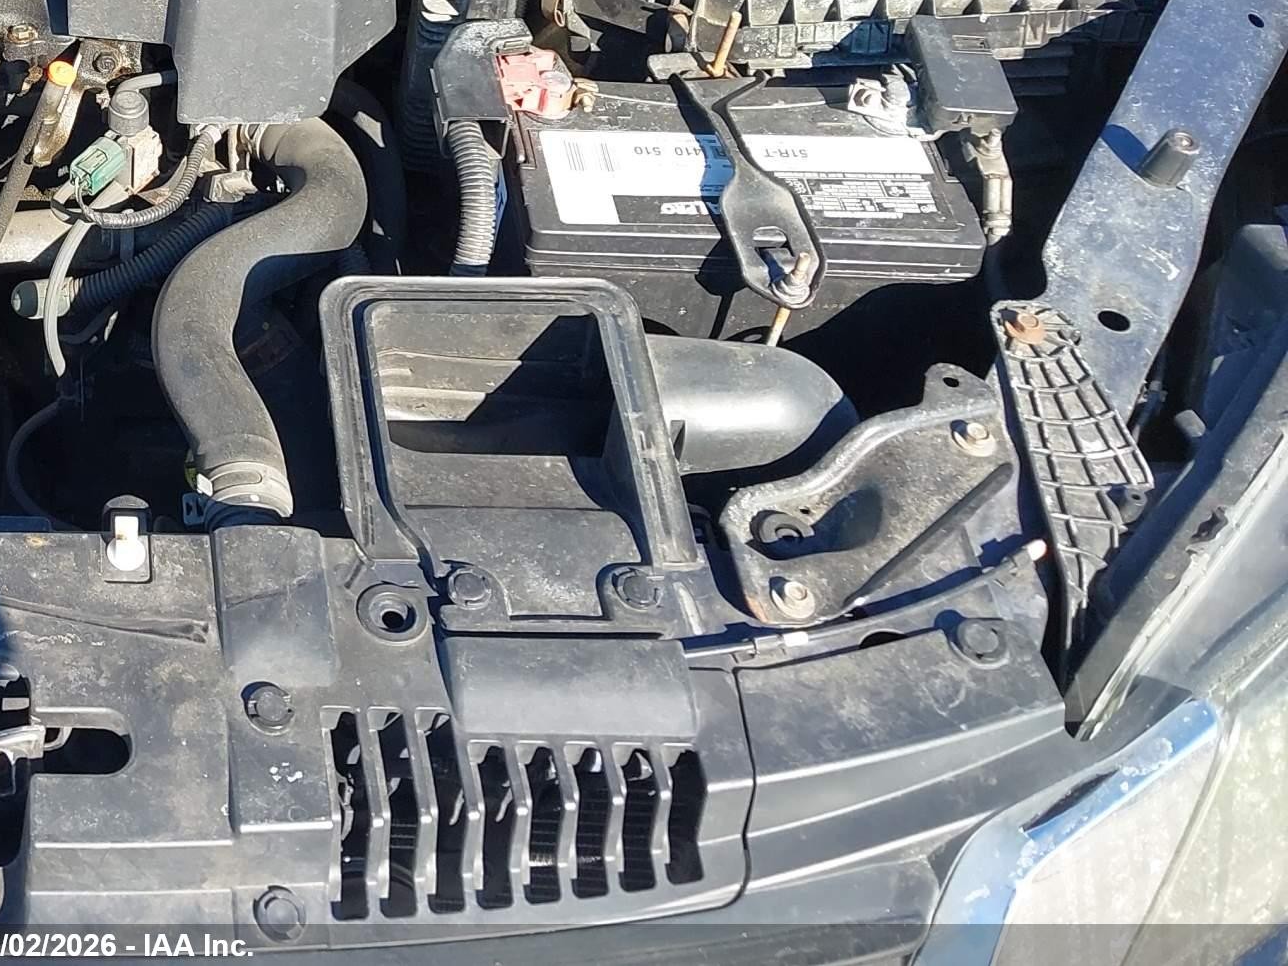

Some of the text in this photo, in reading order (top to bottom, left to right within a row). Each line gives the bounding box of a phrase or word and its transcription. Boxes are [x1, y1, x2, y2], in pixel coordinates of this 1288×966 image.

[634, 146, 701, 156] 410 510
[764, 148, 809, 158] 51R-T
